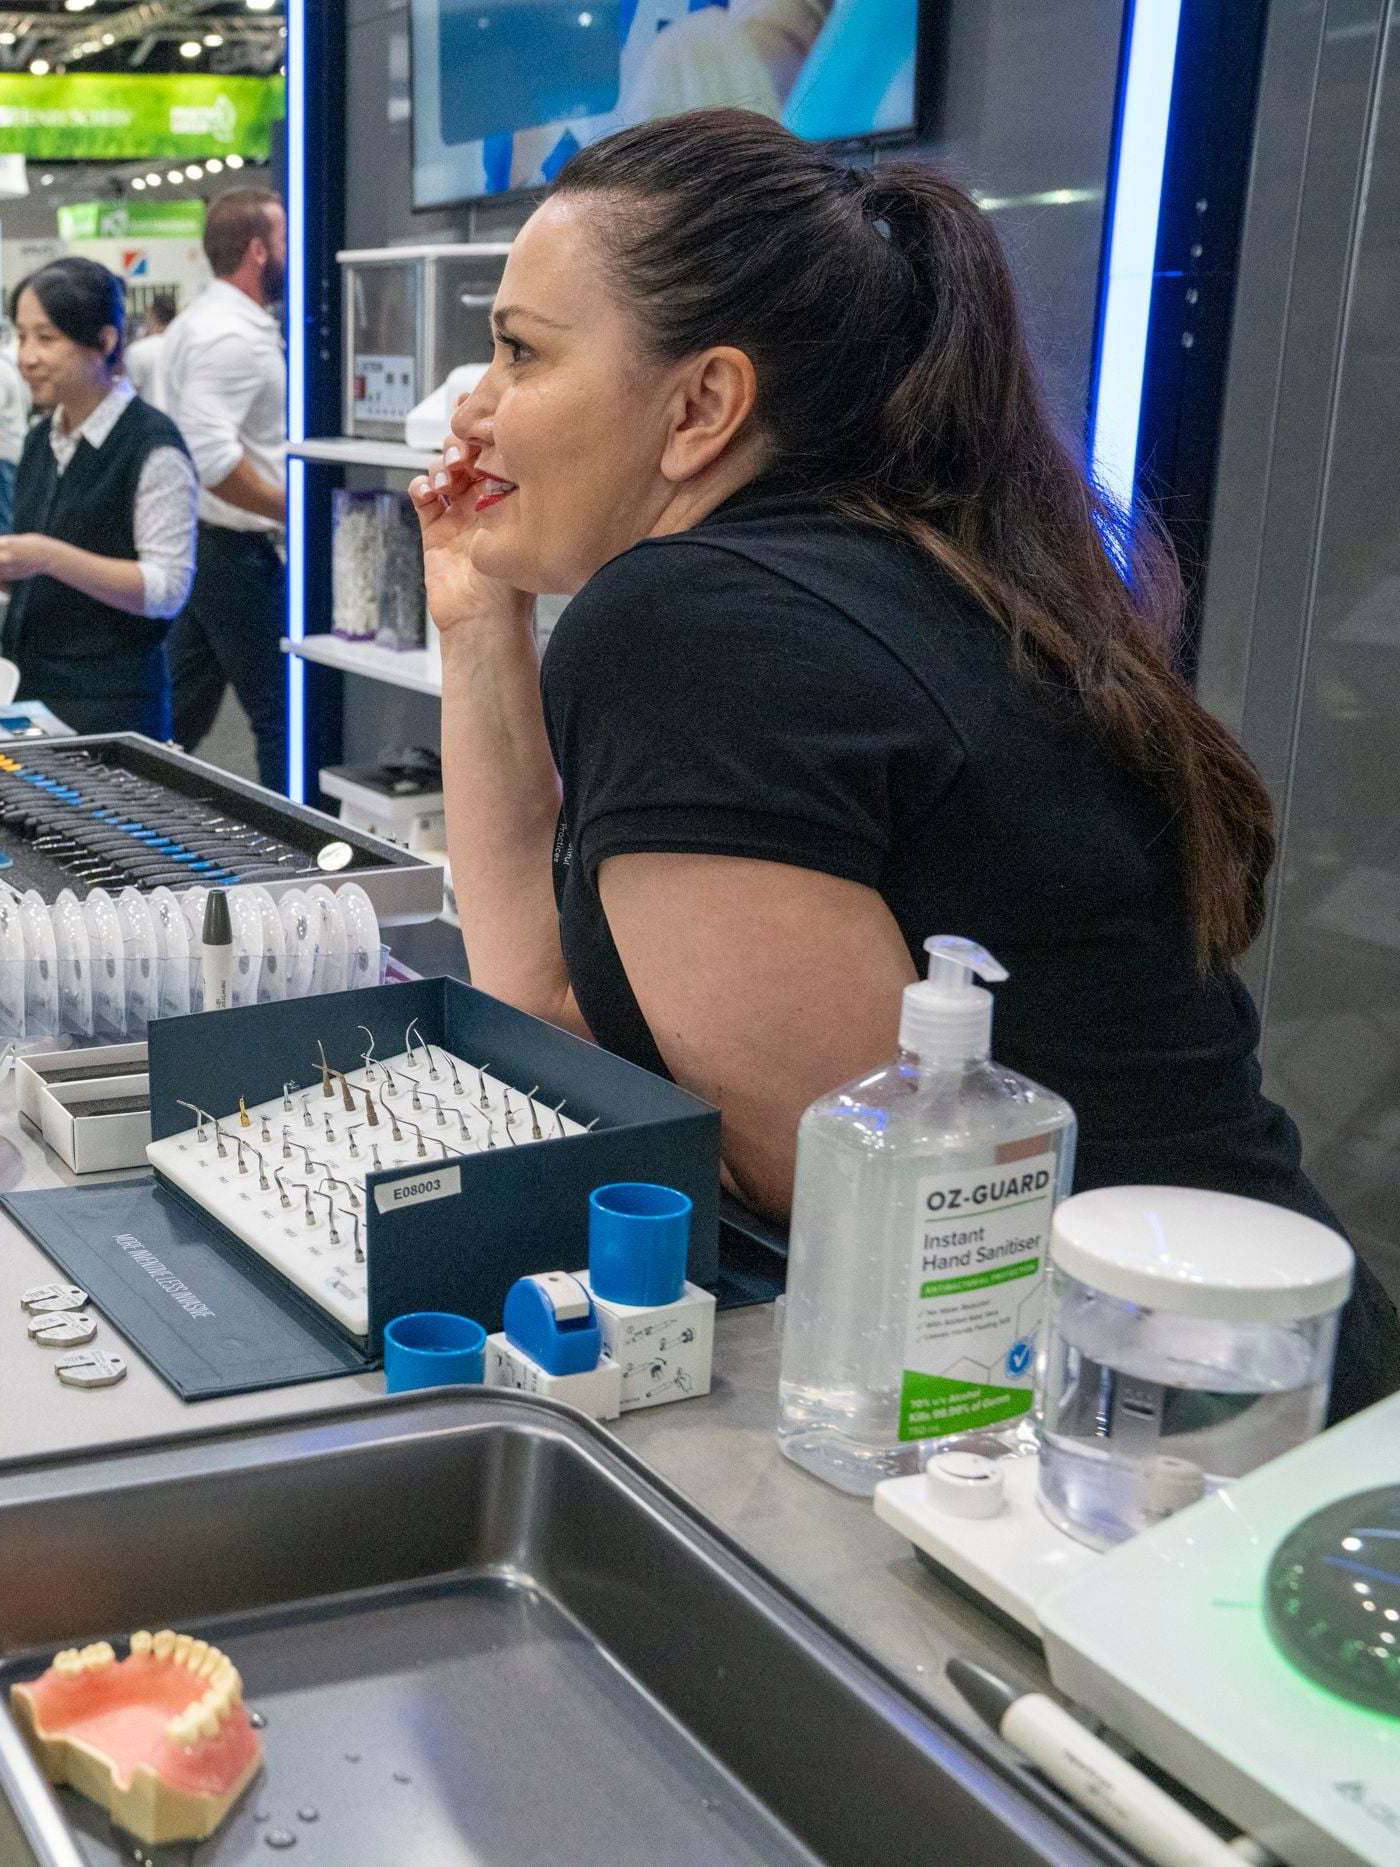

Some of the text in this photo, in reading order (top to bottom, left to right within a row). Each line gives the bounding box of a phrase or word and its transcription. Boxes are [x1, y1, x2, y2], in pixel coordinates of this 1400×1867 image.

[393, 1179, 441, 1200] E08003
[926, 1170, 1049, 1211] OZ-GUARD
[922, 1235, 1042, 1272] Hand Sanitiser
[923, 1226, 985, 1250] Instant
[112, 1233, 216, 1320] MORE INVENTIVE LESS INVASIVE
